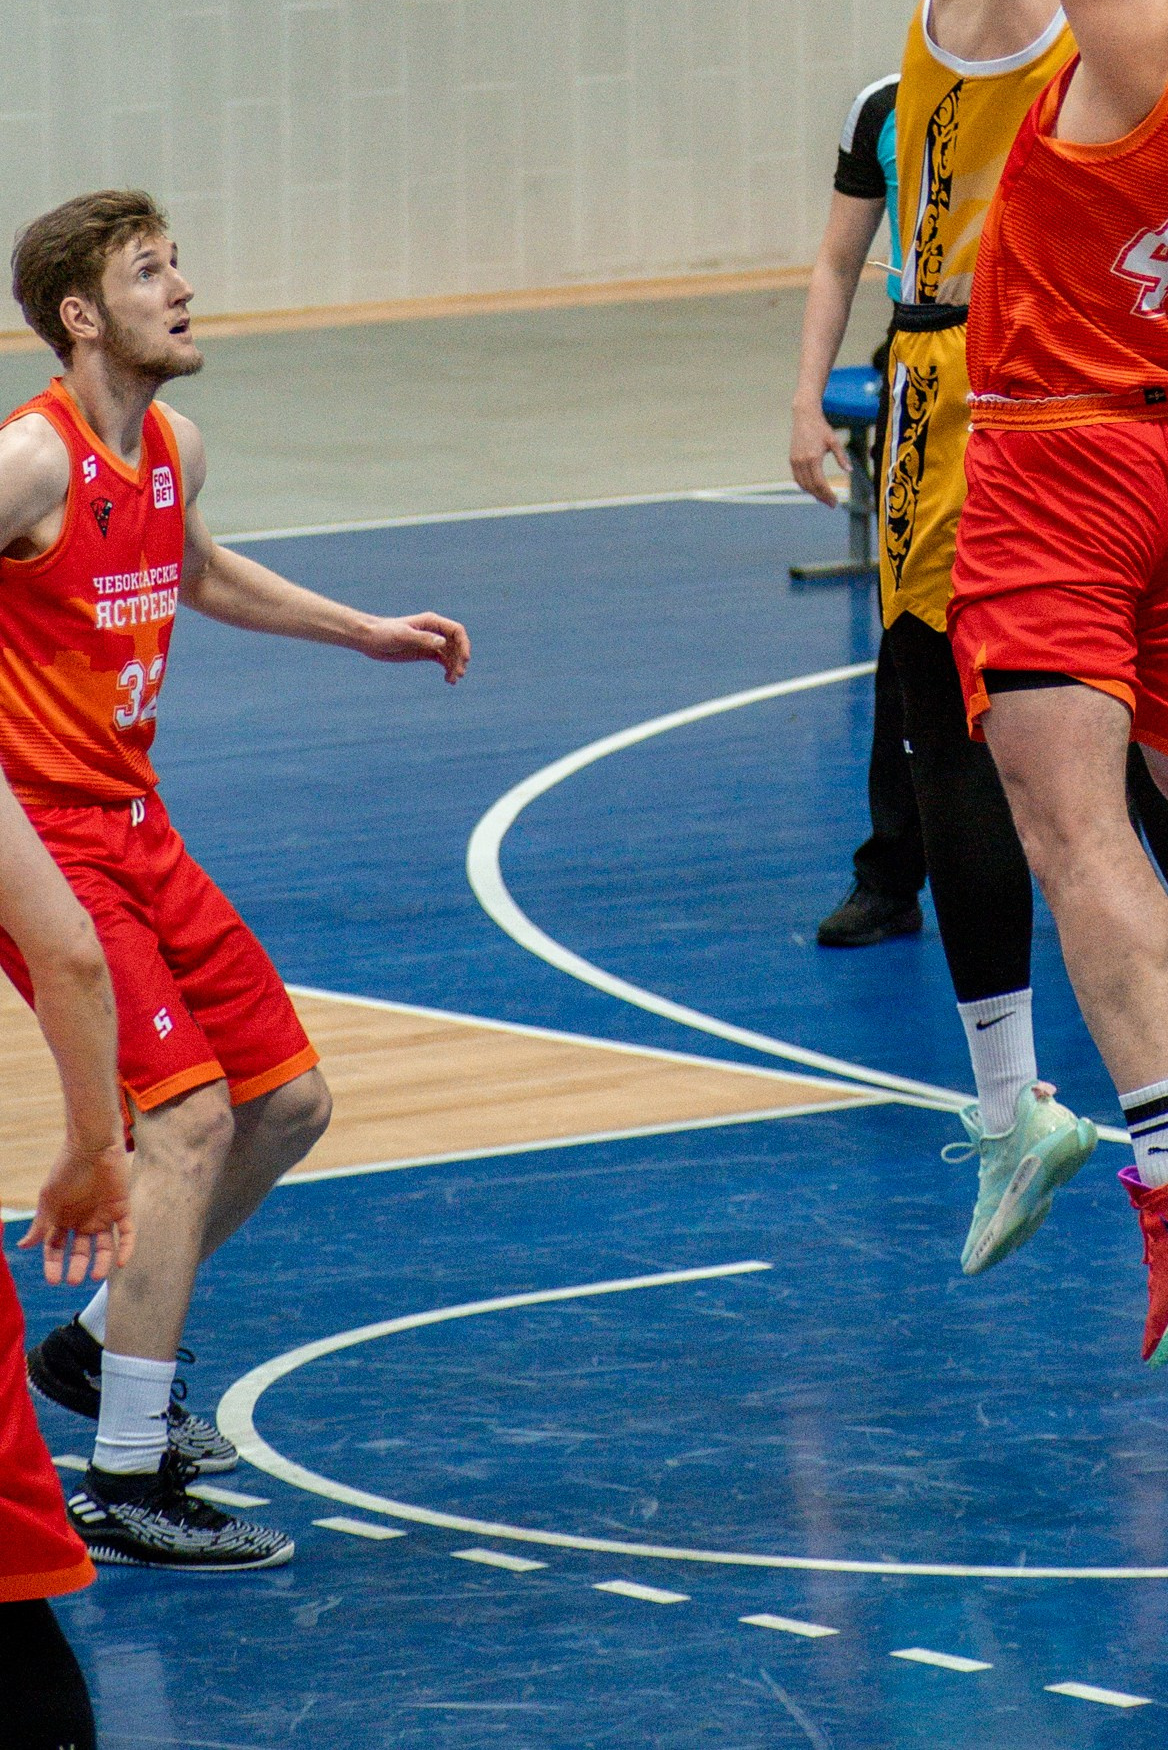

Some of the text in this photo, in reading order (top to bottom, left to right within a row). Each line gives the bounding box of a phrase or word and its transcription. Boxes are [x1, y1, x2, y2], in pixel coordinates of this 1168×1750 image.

[153, 471, 171, 488] FON
[156, 485, 172, 503] BET
[95, 586, 179, 629] ЯСТРЕБЫ
